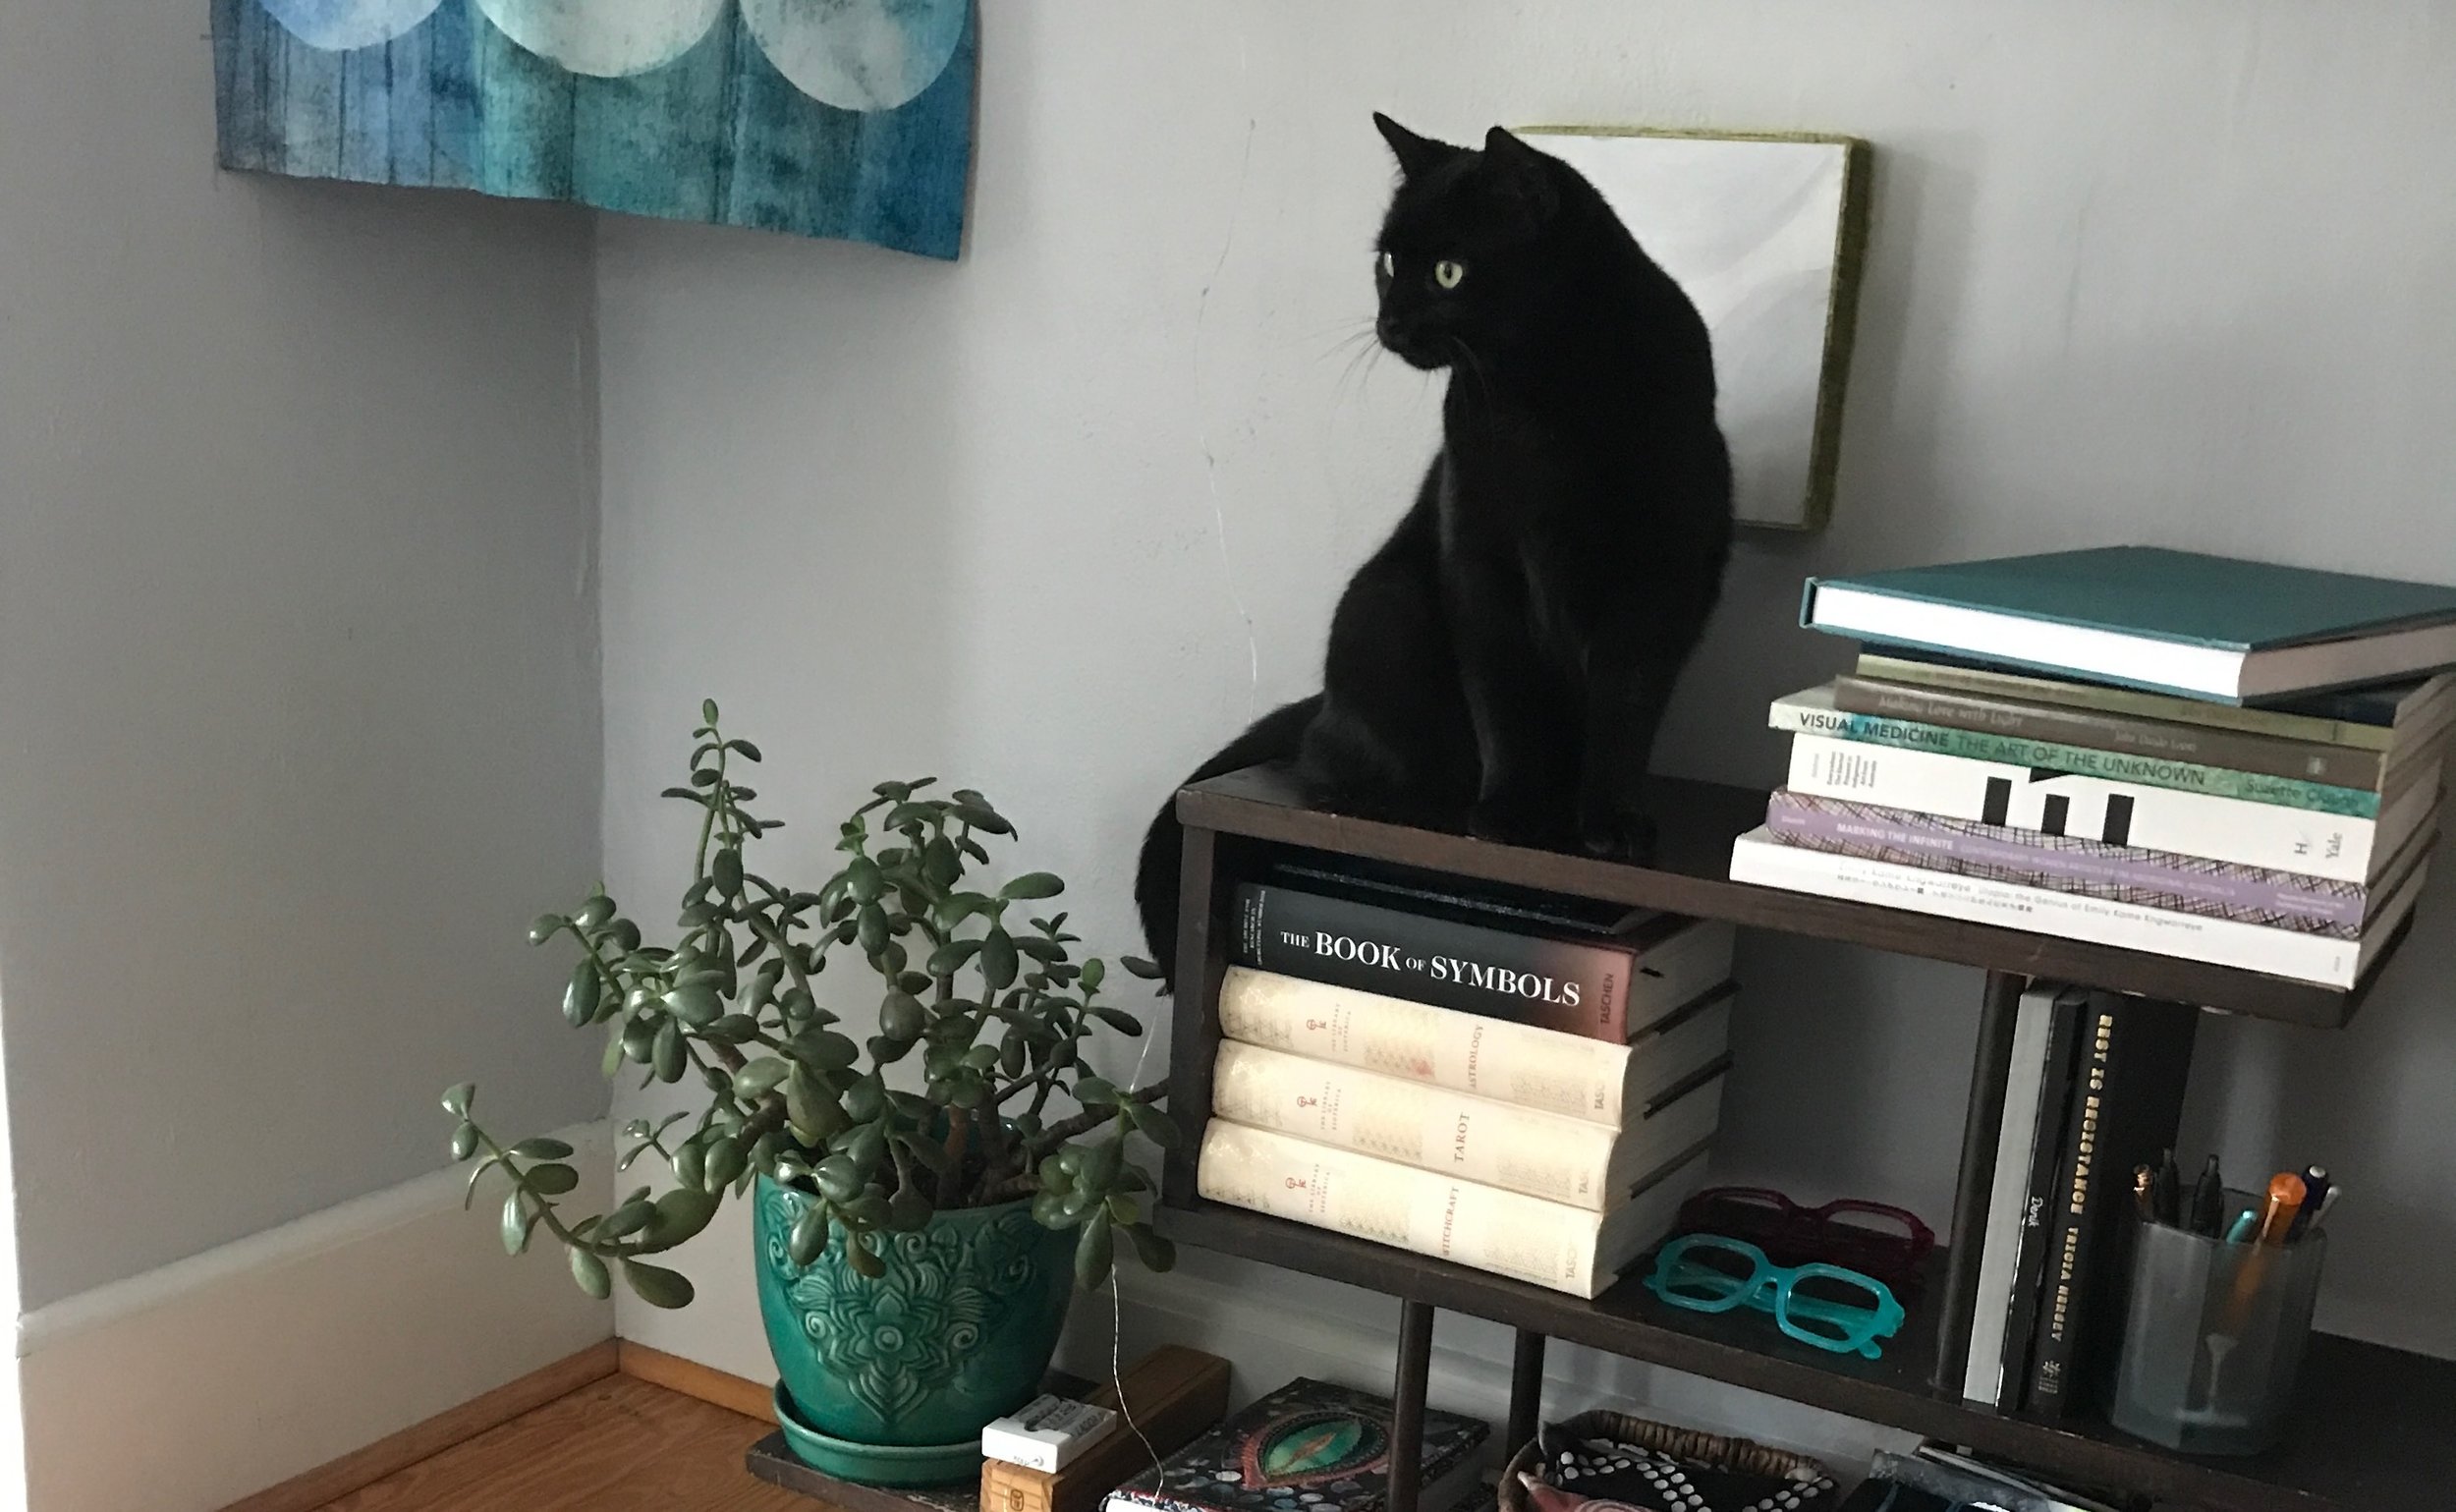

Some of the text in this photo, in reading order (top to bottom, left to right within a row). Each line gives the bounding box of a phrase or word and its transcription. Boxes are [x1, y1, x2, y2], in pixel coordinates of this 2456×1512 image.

[1926, 700, 1955, 718] Love
[1958, 706, 1987, 721] with
[1800, 712, 2205, 786] VISUAL MEDICINE THE ART OF THE UNKNOWN
[1837, 822, 1954, 851] MARKING THE INFINITE
[2325, 832, 2342, 859] Yale
[2084, 903, 2110, 918] Emily
[1280, 930, 1581, 1007] THE BOOK OF SYMBOLS
[1600, 973, 1615, 1025] TASCHEN
[1468, 1025, 1483, 1089] ASTROLOGY
[1454, 1111, 1471, 1163] TAROT
[2070, 1014, 2113, 1214] REST IS RESISTANCE
[1442, 1187, 1460, 1257] WITCHCRAFT
[2028, 1196, 2043, 1227] Denik
[2050, 1227, 2079, 1342] TRICIA HERSEY
